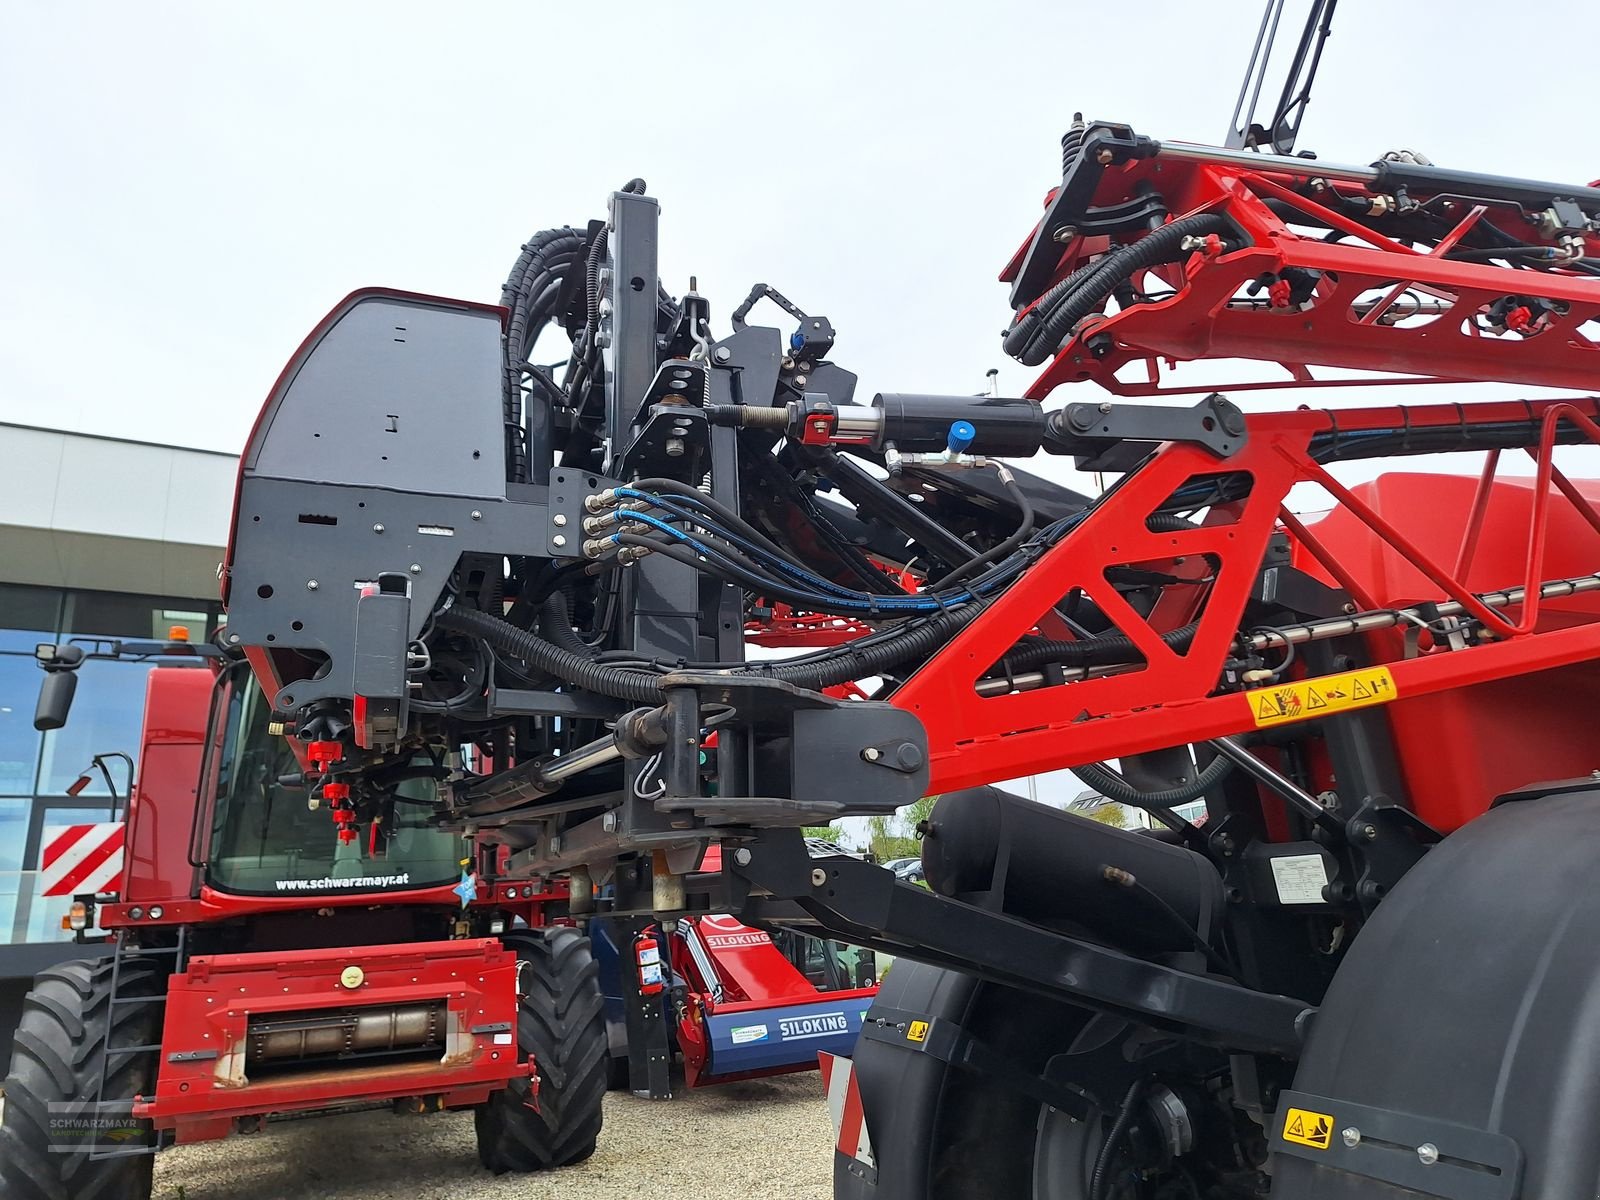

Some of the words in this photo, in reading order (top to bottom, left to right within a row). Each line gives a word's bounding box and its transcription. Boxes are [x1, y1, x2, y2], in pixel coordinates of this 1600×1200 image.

[276, 873, 409, 890] www.schwarzmayr.at
[707, 933, 770, 946] SILOKING
[780, 1016, 847, 1036] SILOKING
